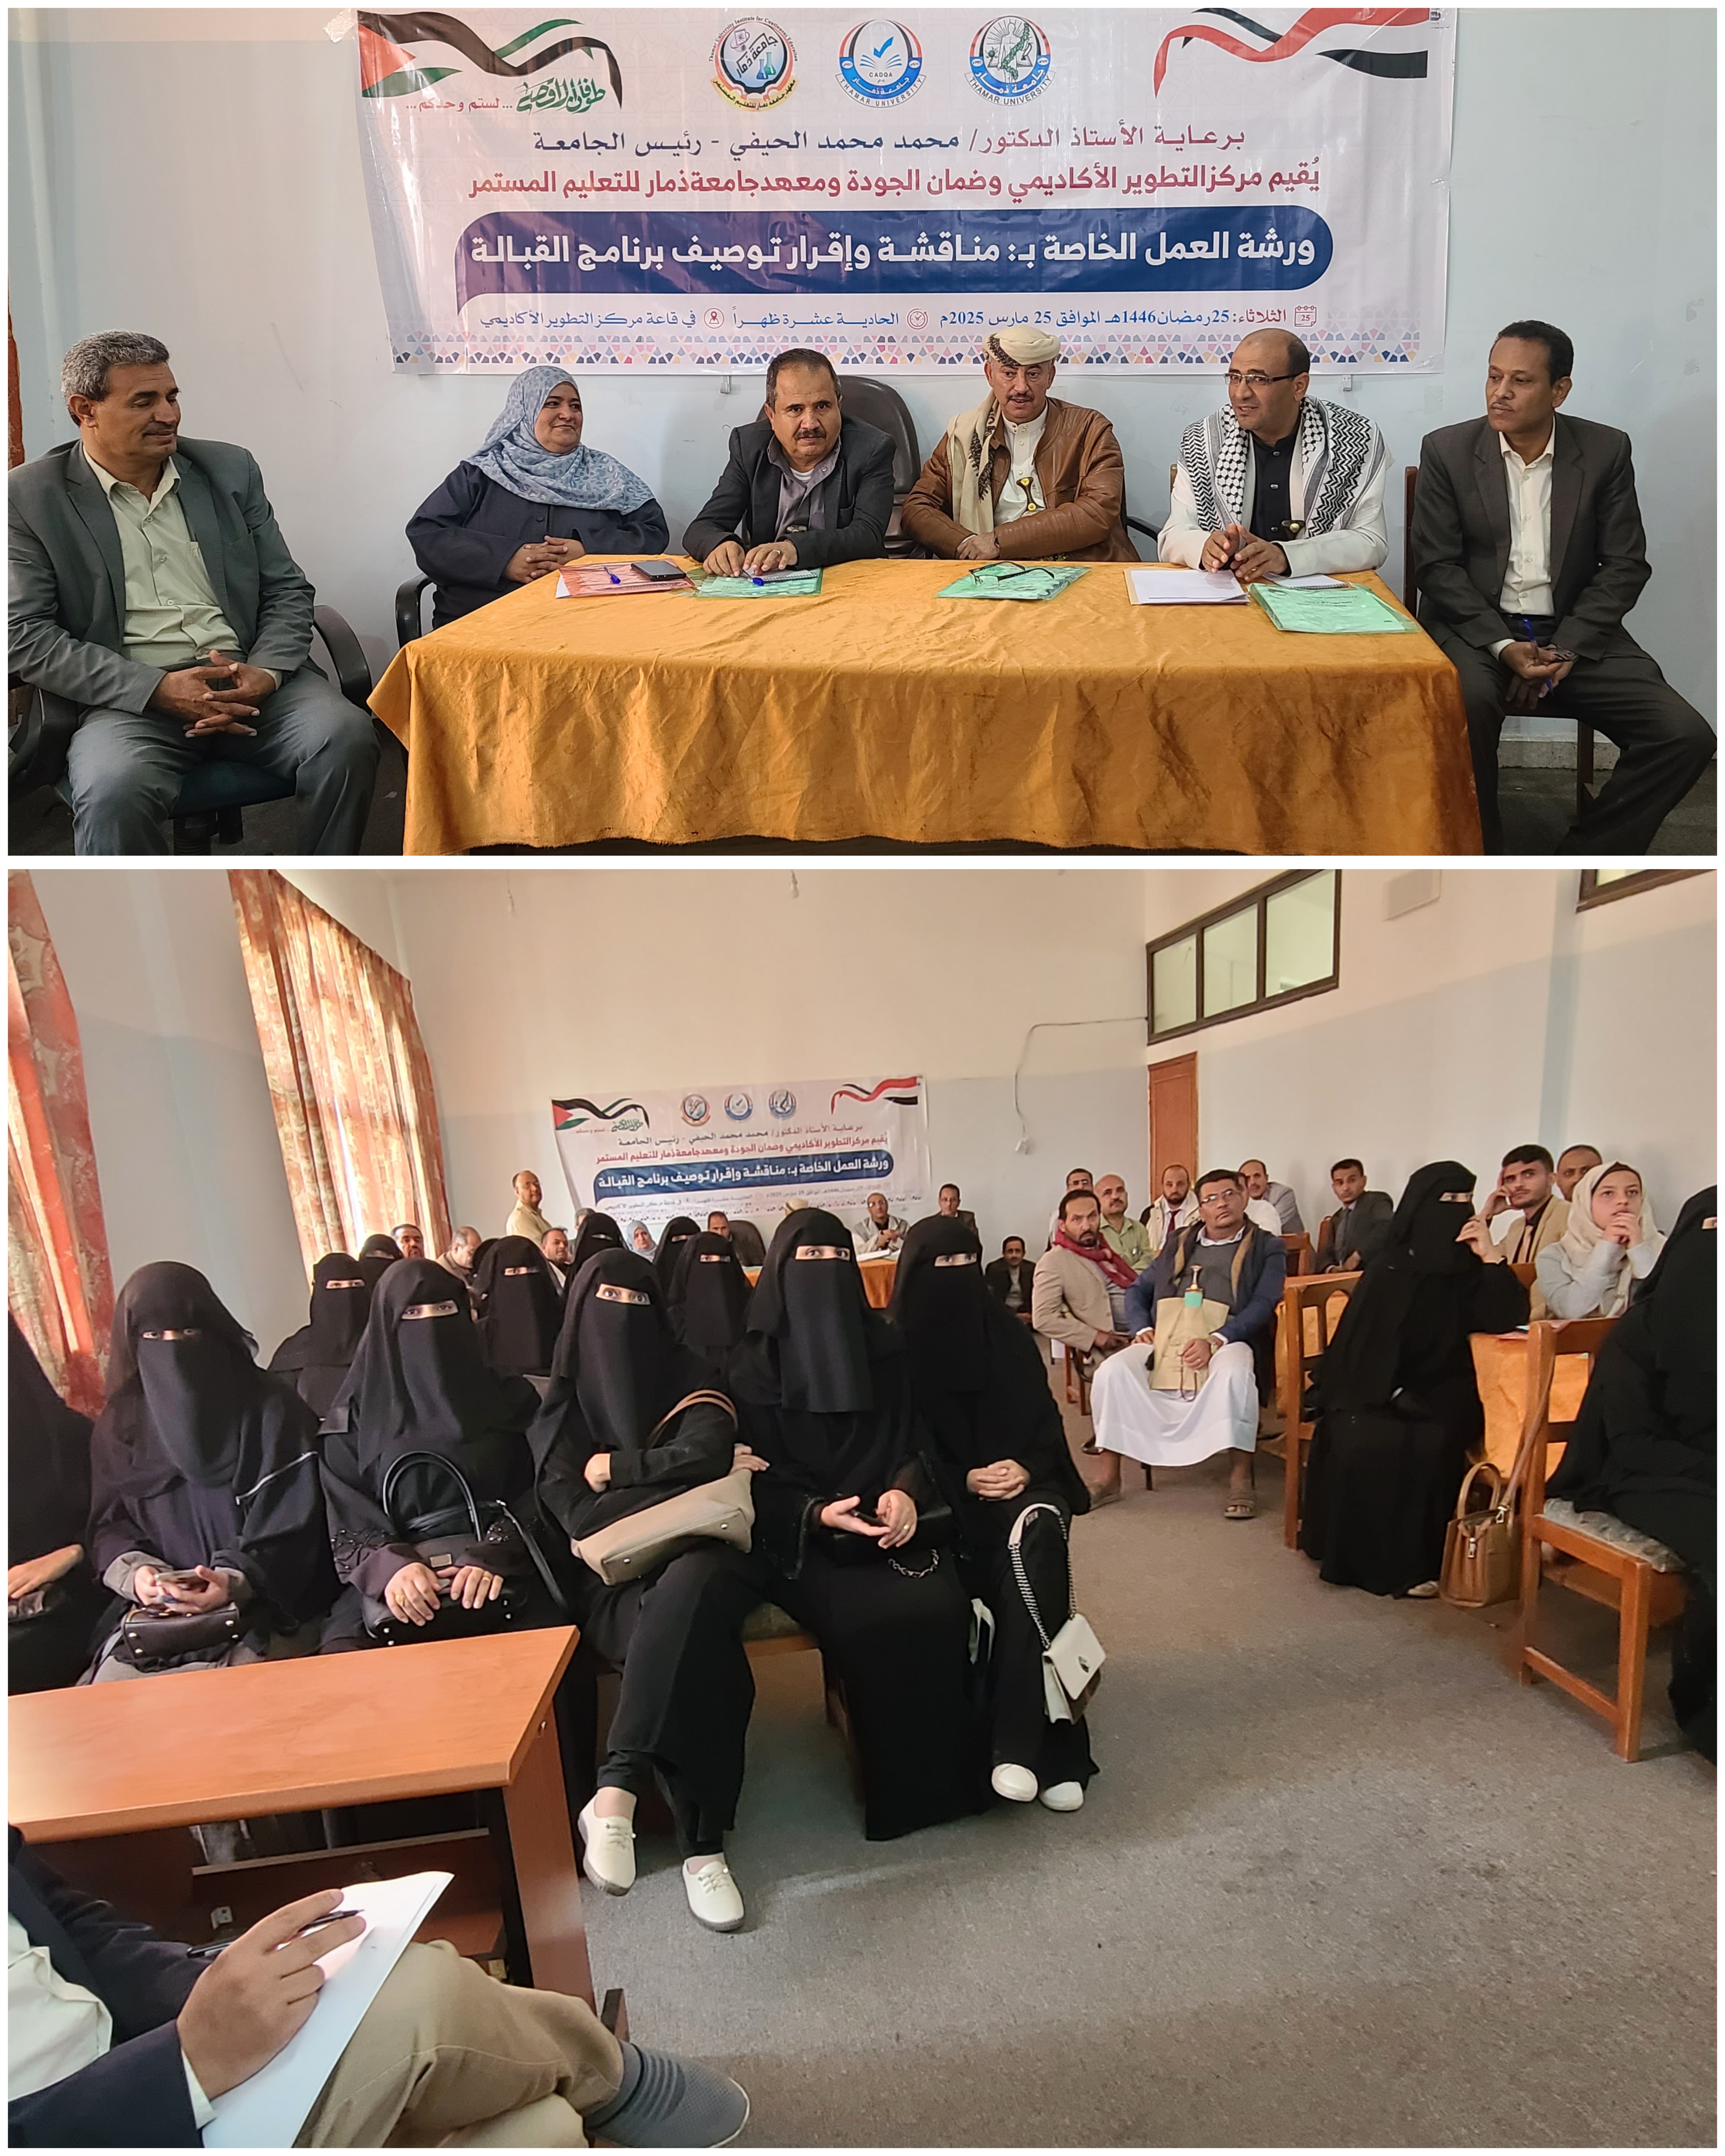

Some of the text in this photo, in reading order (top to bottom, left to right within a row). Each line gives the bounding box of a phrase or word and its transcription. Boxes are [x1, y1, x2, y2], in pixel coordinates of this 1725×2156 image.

[715, 23, 734, 42] University
[764, 18, 788, 37] Continuous
[787, 37, 798, 61] Education
[736, 32, 778, 78] جامعة ذمار
[840, 78, 922, 106] THAMAR UNIVERSITY
[852, 77, 910, 95] جامعة ذمار
[969, 75, 1051, 105] THAMAR UNIVERSITY
[975, 70, 1045, 93] جامعة ذمار
[534, 131, 624, 156] الجامعة
[636, 131, 701, 157] رئيس
[818, 136, 883, 150] محمد
[895, 135, 959, 150] محمد
[1071, 120, 1143, 146] الأستاذ
[1154, 125, 1244, 152] برعاية
[730, 131, 806, 162] الحيفي
[469, 170, 555, 198] المستمر
[563, 170, 639, 199] للتعليم
[847, 169, 919, 197] الجودة
[927, 168, 1001, 196] وضمان
[1009, 163, 1116, 204] الأكاديمي
[472, 235, 569, 270] القبالة
[578, 235, 664, 271] برنامج
[672, 235, 782, 271] توصيف
[786, 232, 870, 271] وإقرار
[879, 231, 999, 262] مناقشة
[1044, 232, 1135, 260] الخاصة
[1146, 232, 1228, 265] العمل
[1238, 227, 1314, 265] ورشة
[646, 312, 678, 324] قاعة
[682, 310, 696, 328] في
[782, 312, 834, 328] عشرة
[837, 312, 899, 328] الحادية
[940, 311, 984, 328] 2025م
[988, 311, 1028, 327] مارس
[1034, 311, 1051, 323] 25
[1056, 310, 1100, 327] الموافق
[596, 1153, 628, 1163] المستمر
[630, 1150, 658, 1162] للتعليم
[799, 1161, 831, 1172] الخاصة
[833, 1158, 861, 1172] العمل
[863, 1156, 889, 1170] ورشة
[599, 1175, 635, 1189] القبالة
[637, 1173, 668, 1187] برنامج
[671, 1170, 710, 1183] توصيف
